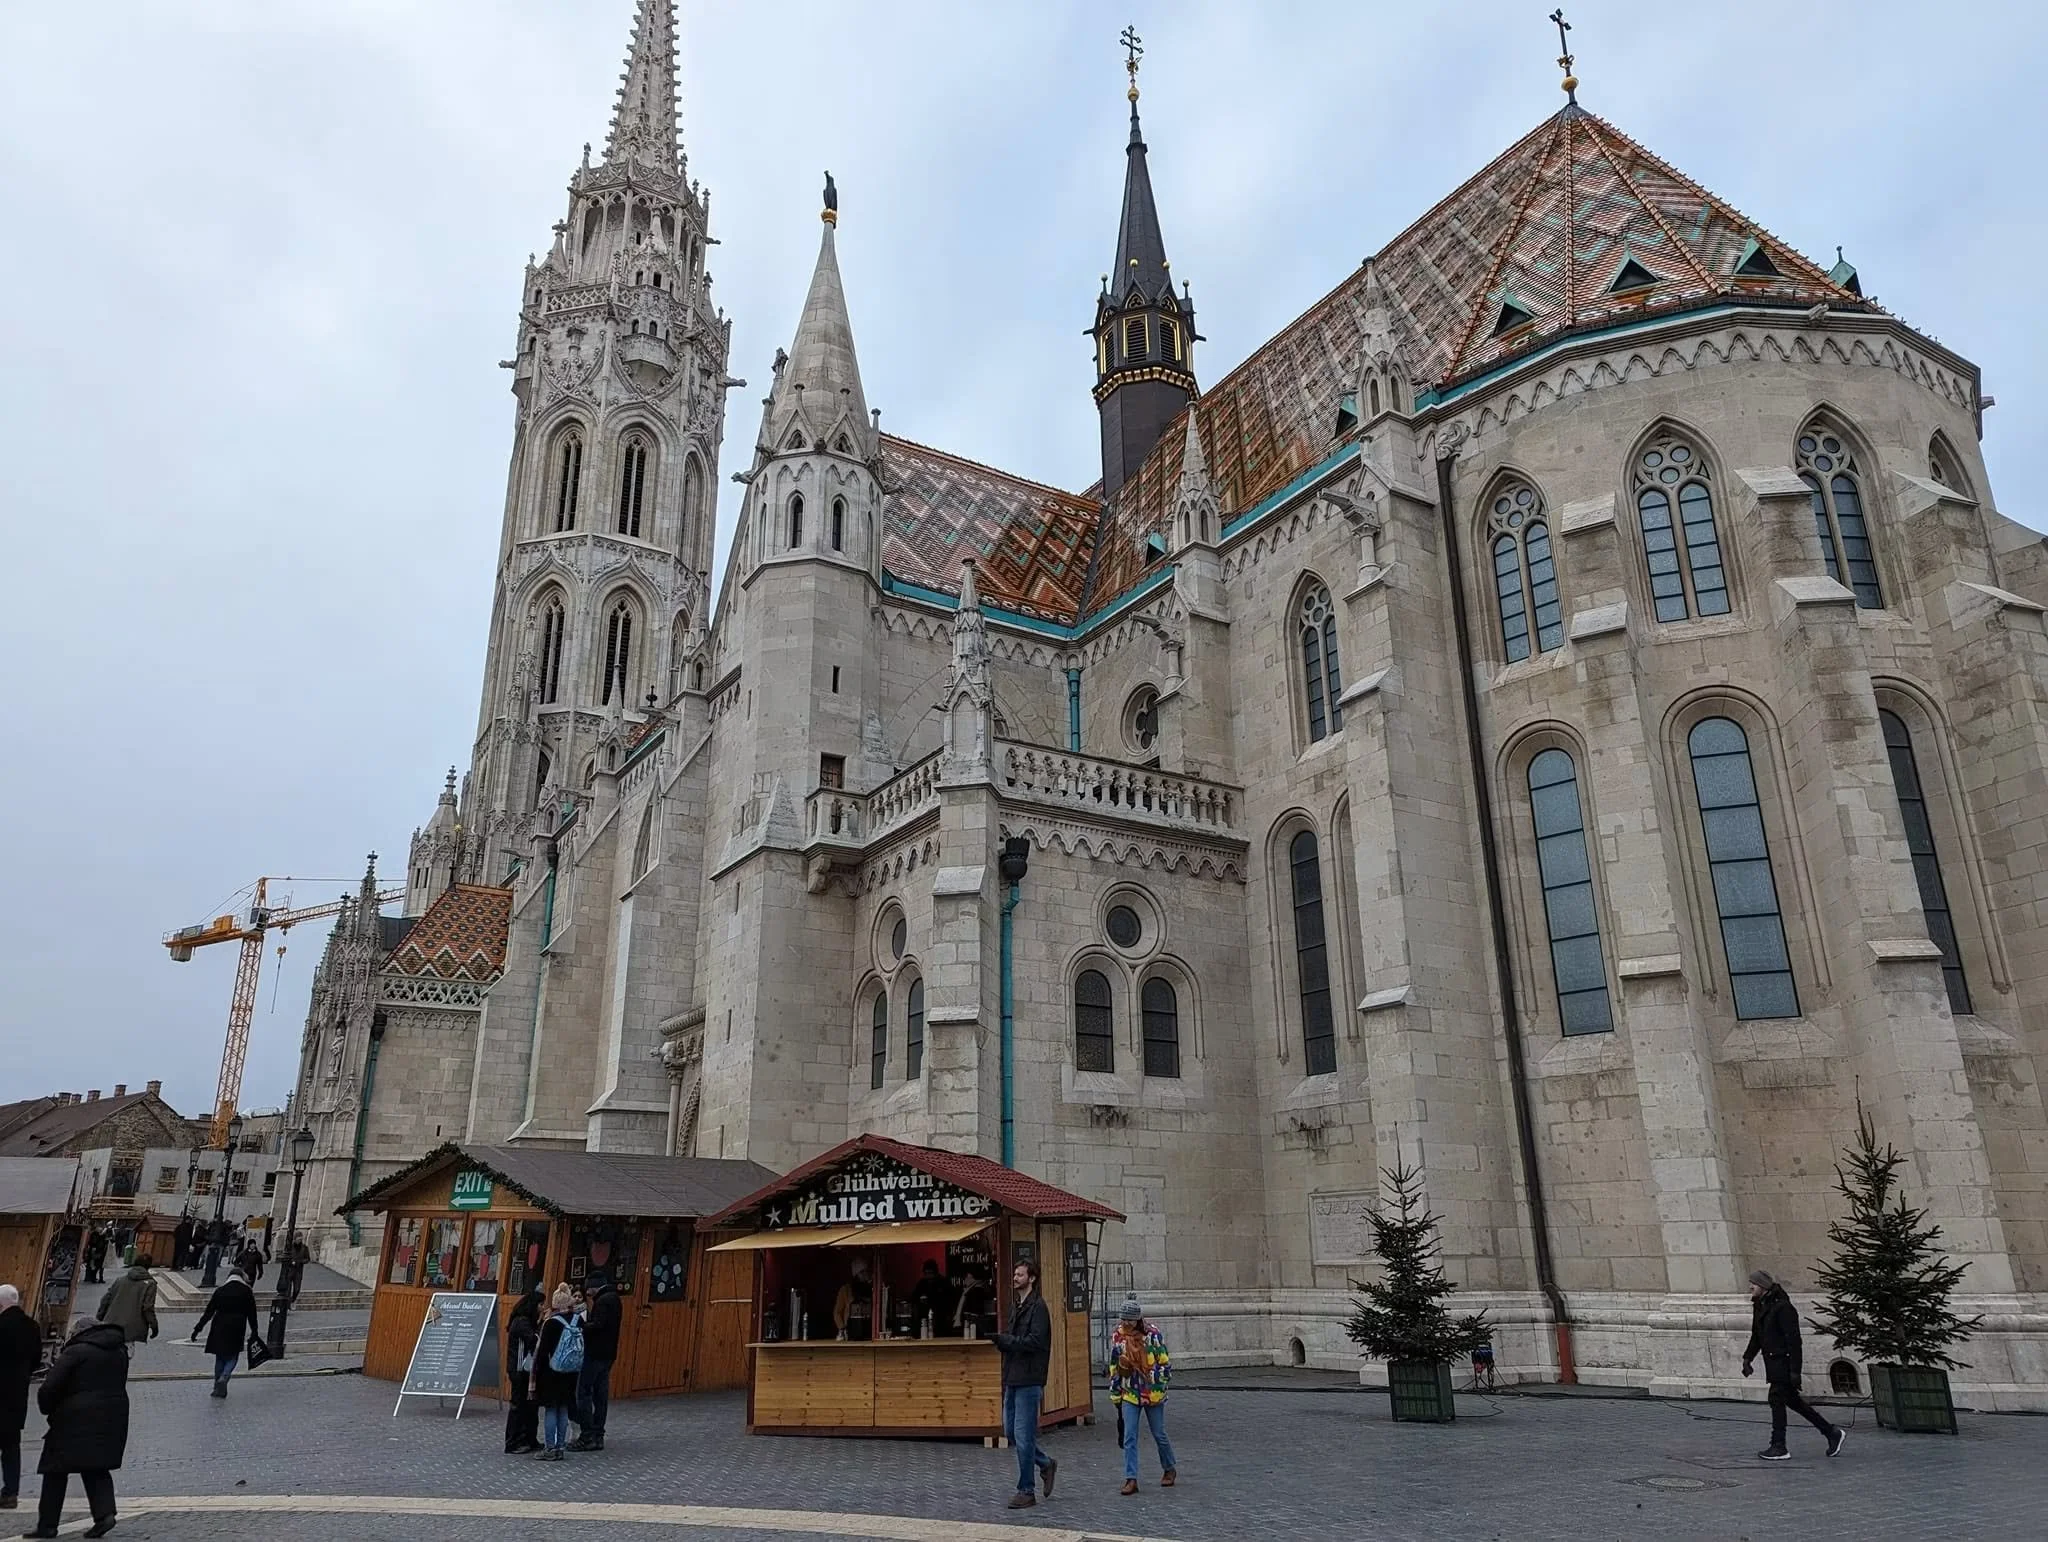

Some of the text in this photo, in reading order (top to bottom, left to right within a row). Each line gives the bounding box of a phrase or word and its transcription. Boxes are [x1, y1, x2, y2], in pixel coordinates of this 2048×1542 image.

[454, 1171, 485, 1193] EXIT
[827, 1170, 934, 1194] Glühwein
[788, 1193, 982, 1225] Mulled wine
